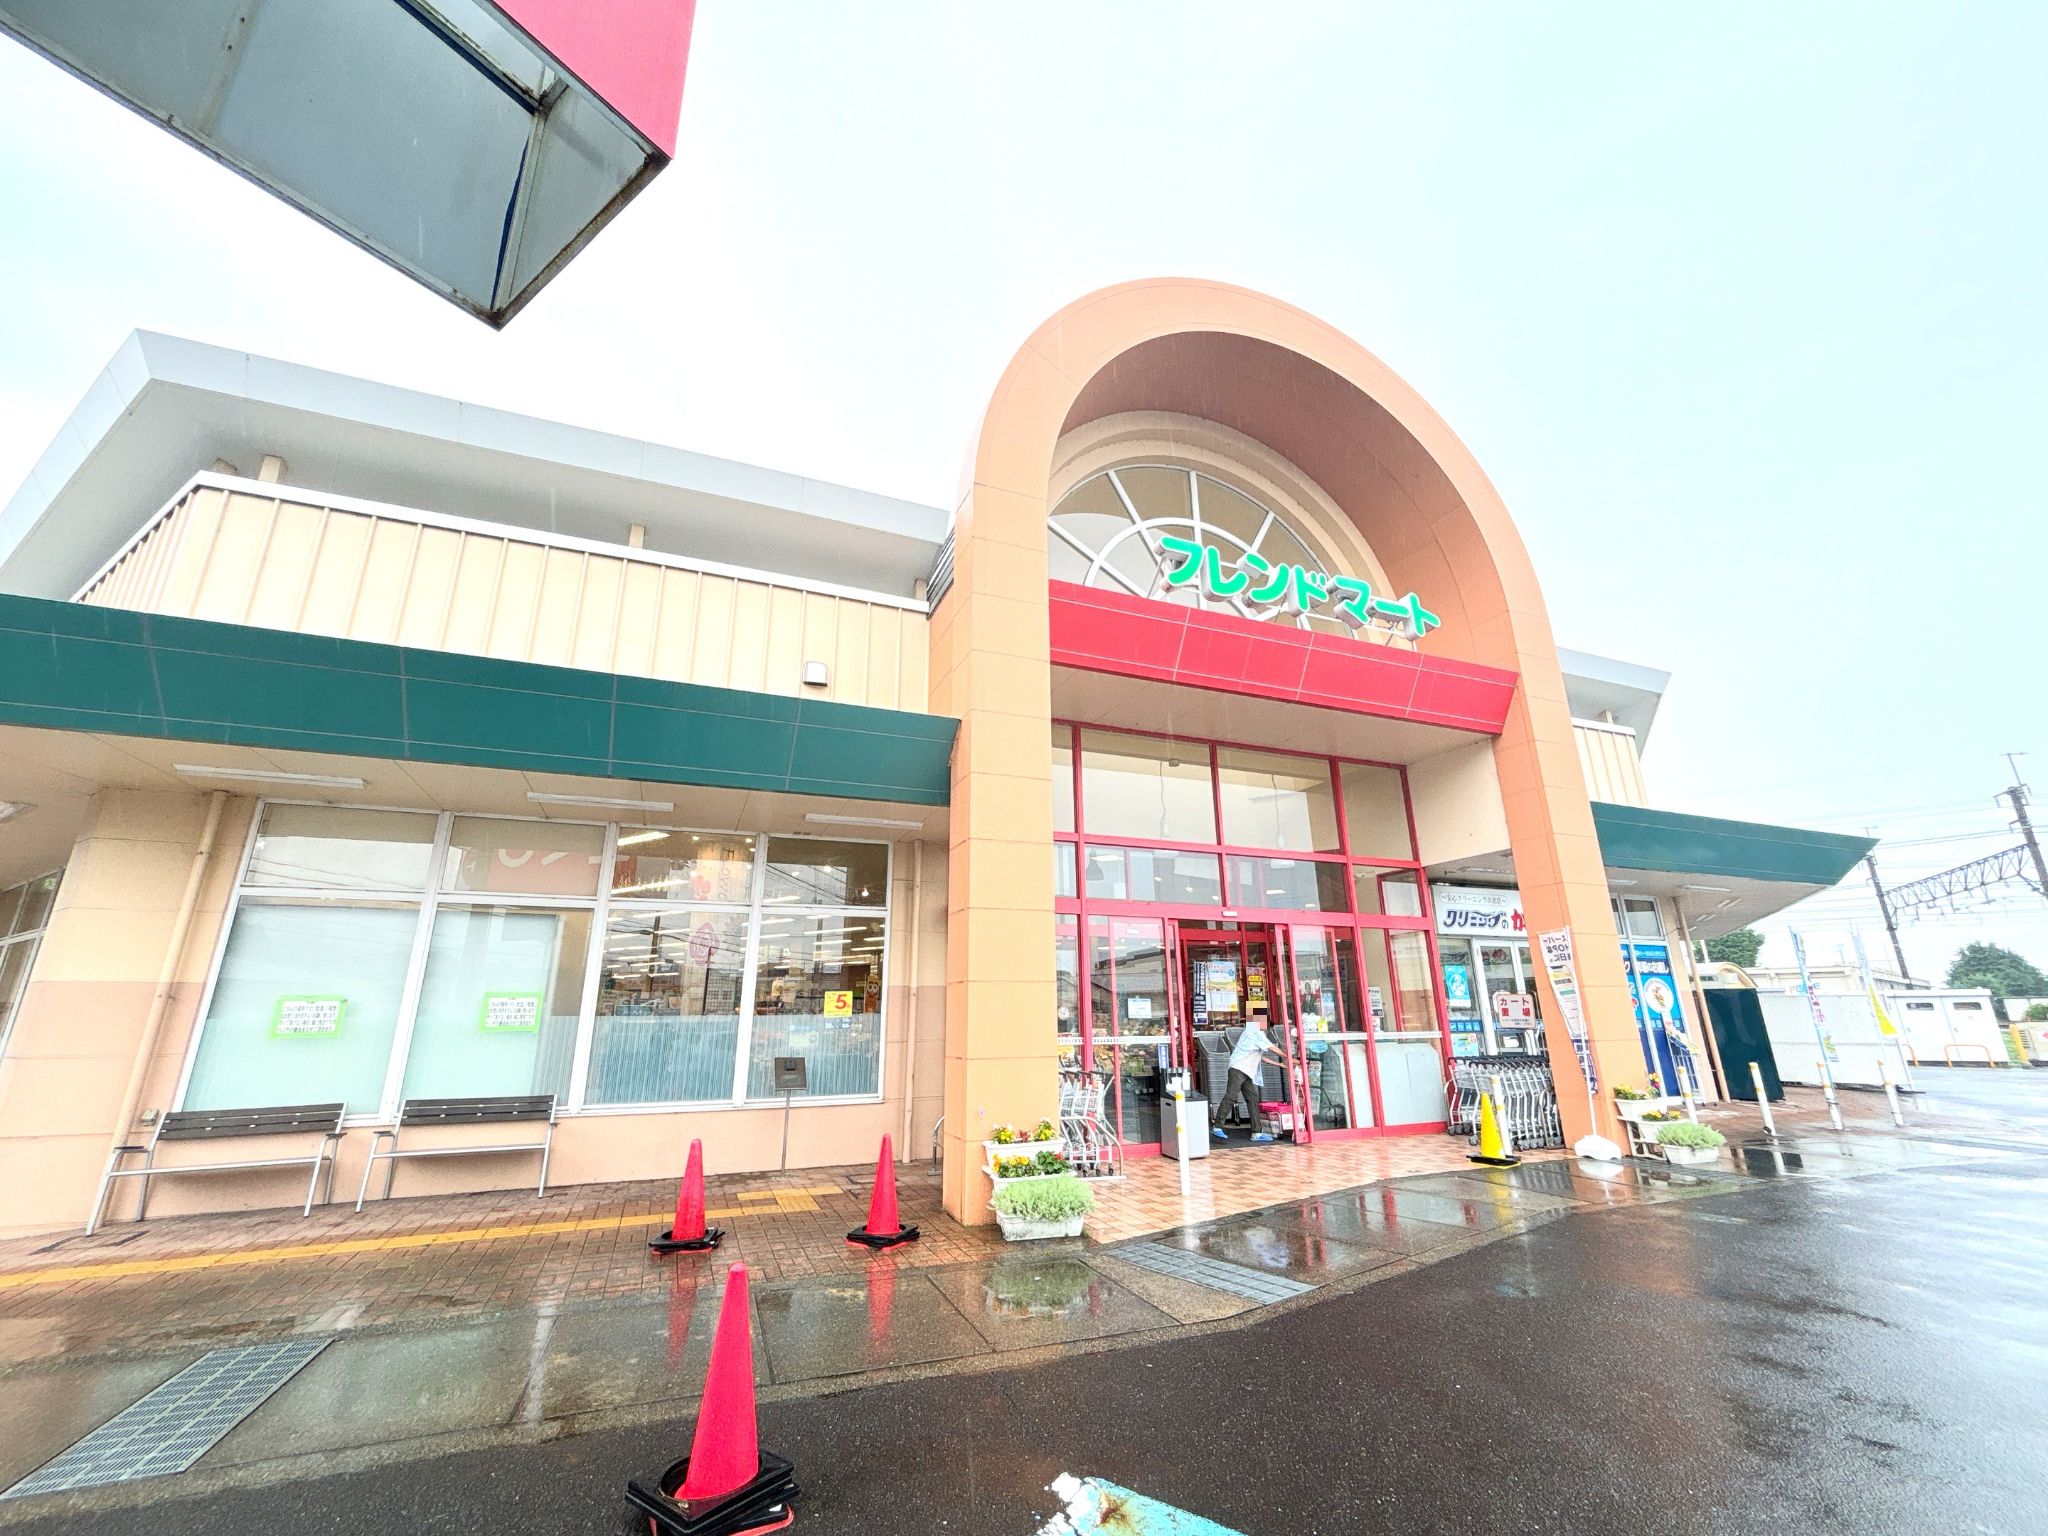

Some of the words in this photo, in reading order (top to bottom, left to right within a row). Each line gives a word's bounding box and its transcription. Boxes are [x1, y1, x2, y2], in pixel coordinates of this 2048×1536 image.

[1159, 536, 1441, 638] フレンドマート
[1499, 997, 1530, 1006] カート
